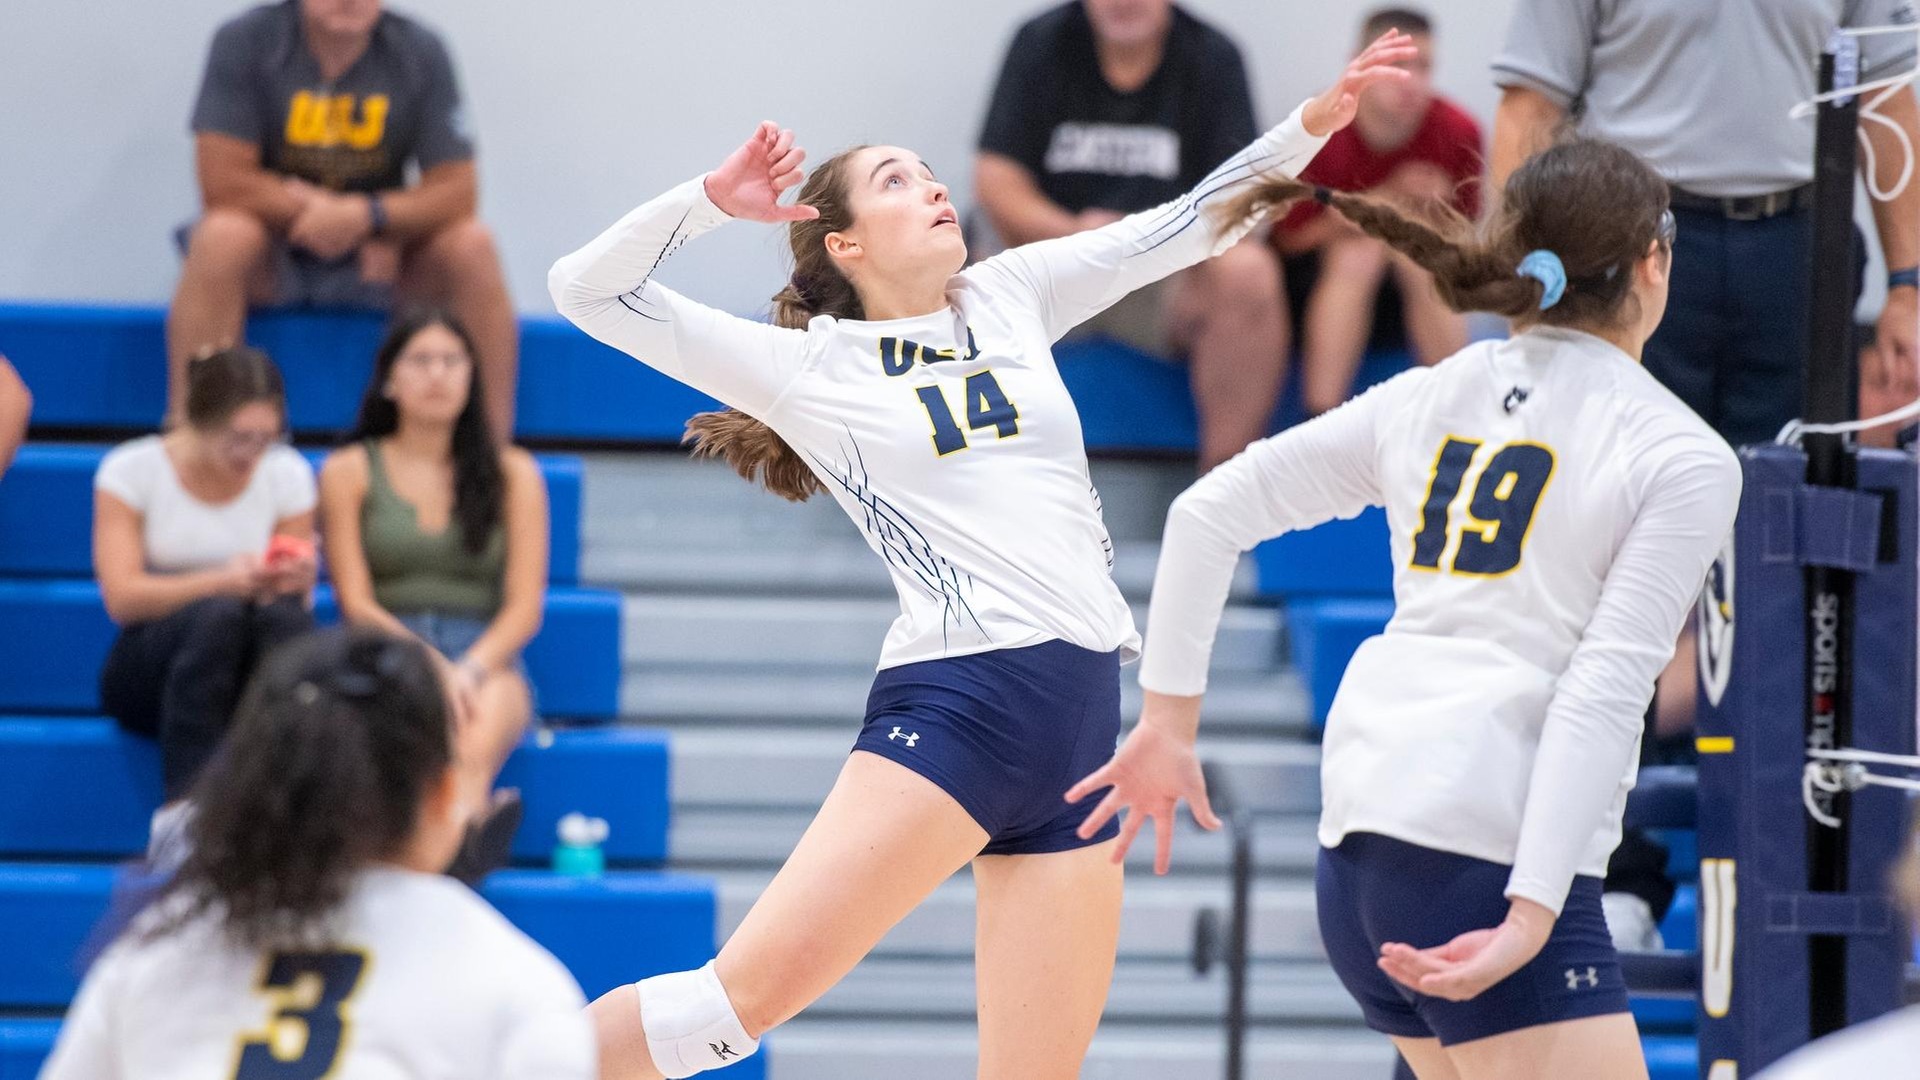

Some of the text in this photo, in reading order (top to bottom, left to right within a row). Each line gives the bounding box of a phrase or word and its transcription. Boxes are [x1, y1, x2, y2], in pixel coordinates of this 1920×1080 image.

[913, 367, 1022, 457] 14
[1408, 433, 1558, 580] 19
[228, 944, 374, 1080] 3
